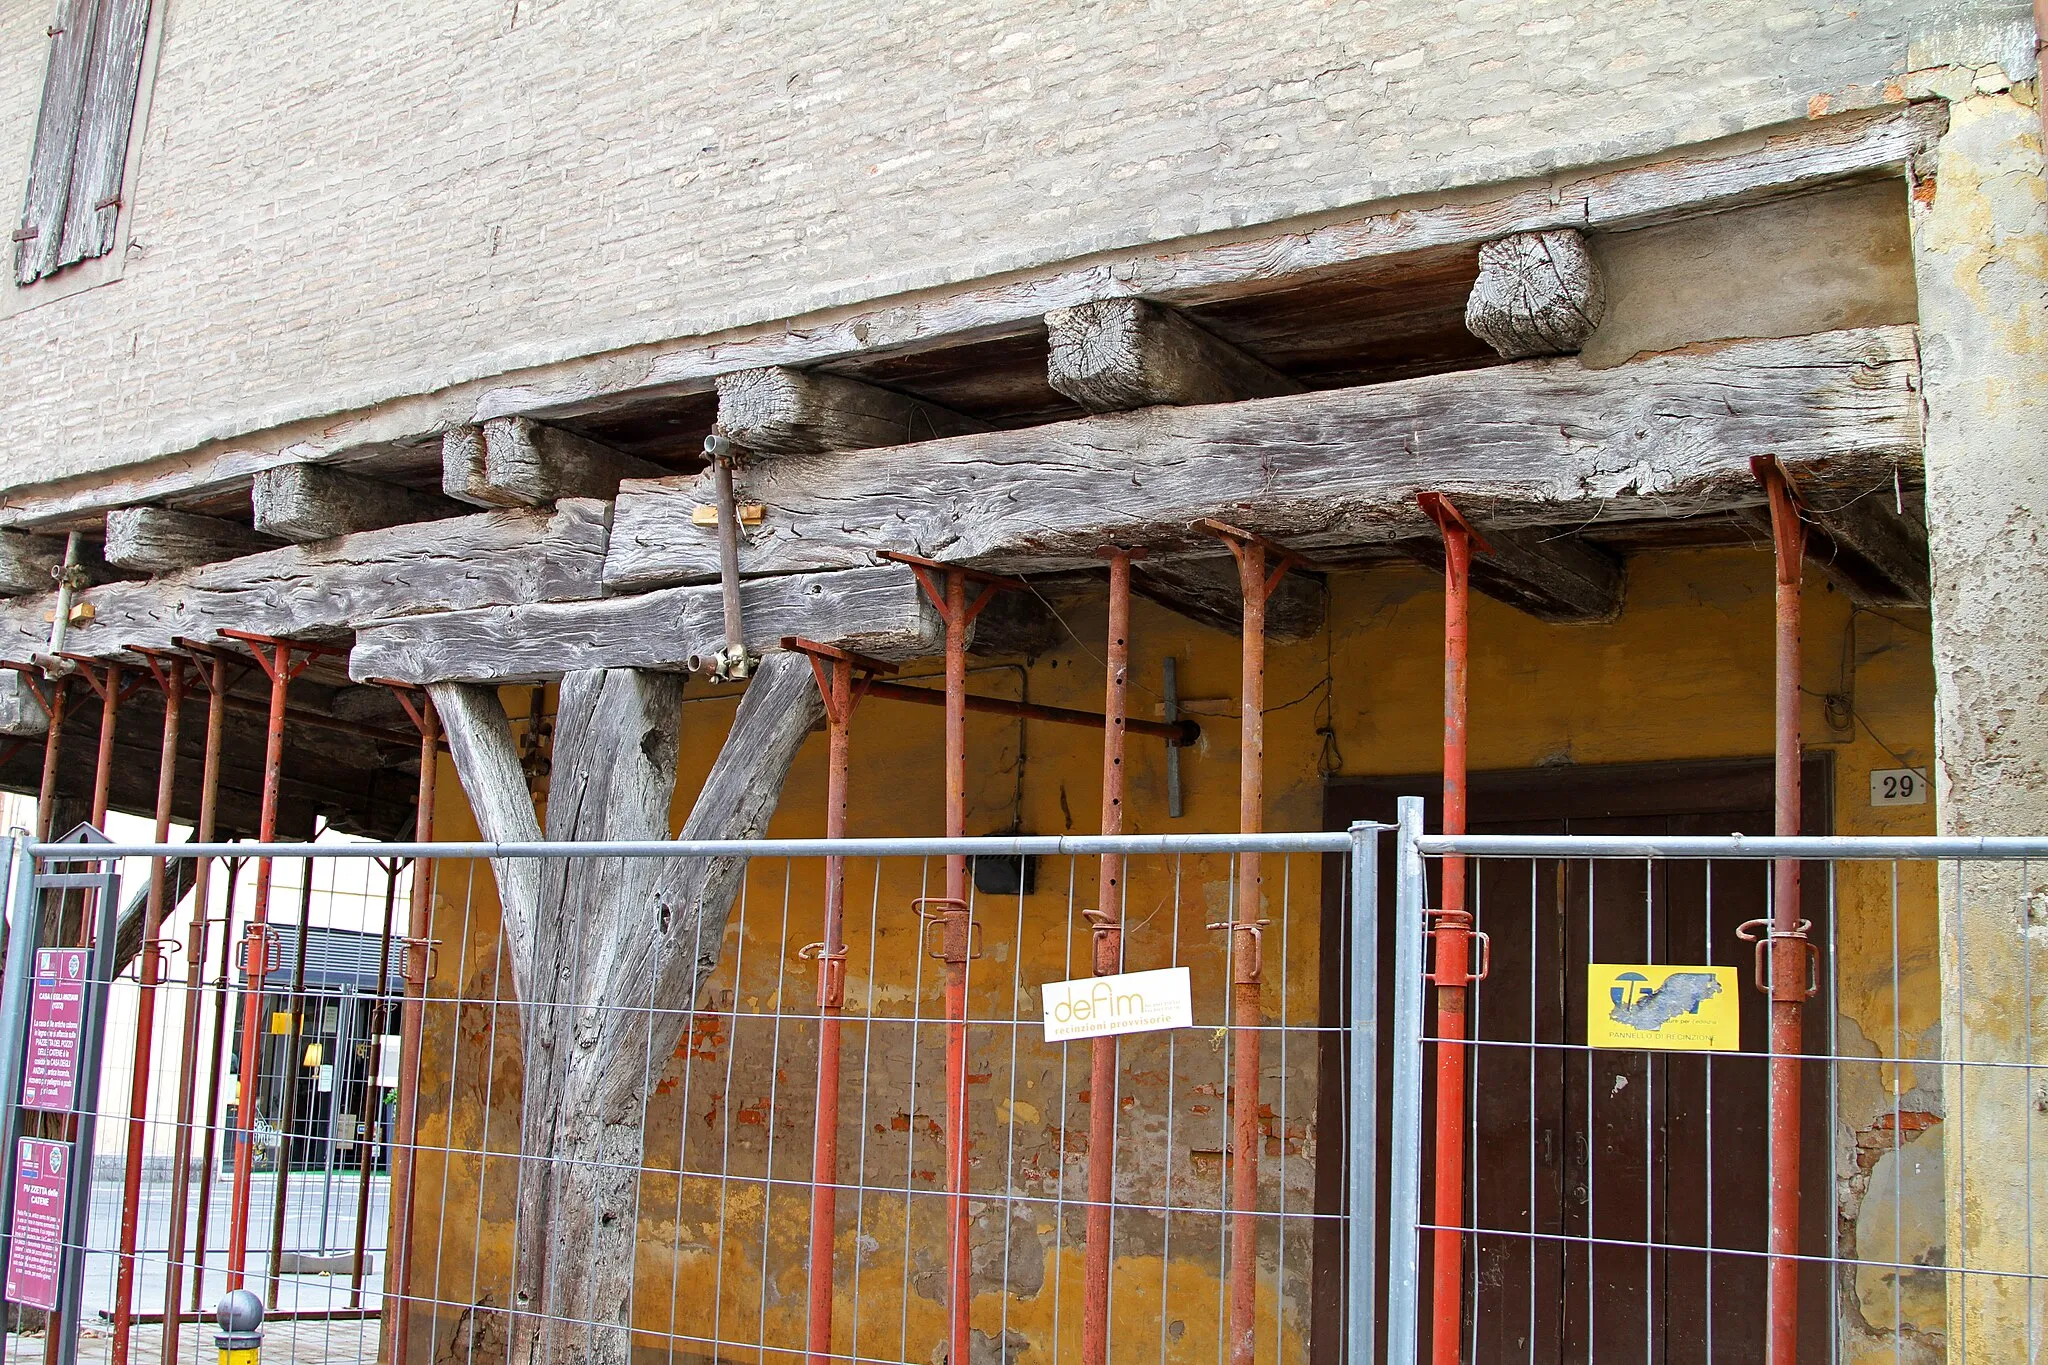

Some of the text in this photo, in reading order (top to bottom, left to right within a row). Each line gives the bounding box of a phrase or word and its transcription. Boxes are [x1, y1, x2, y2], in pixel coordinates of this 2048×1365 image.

[1884, 776, 1913, 798] 29
[1055, 1014, 1172, 1035] recinzioni provvisorie
[1609, 1031, 1652, 1040] PANNELLO
[1655, 1032, 1664, 1040] DI
[31, 1196, 49, 1206] CATENE
